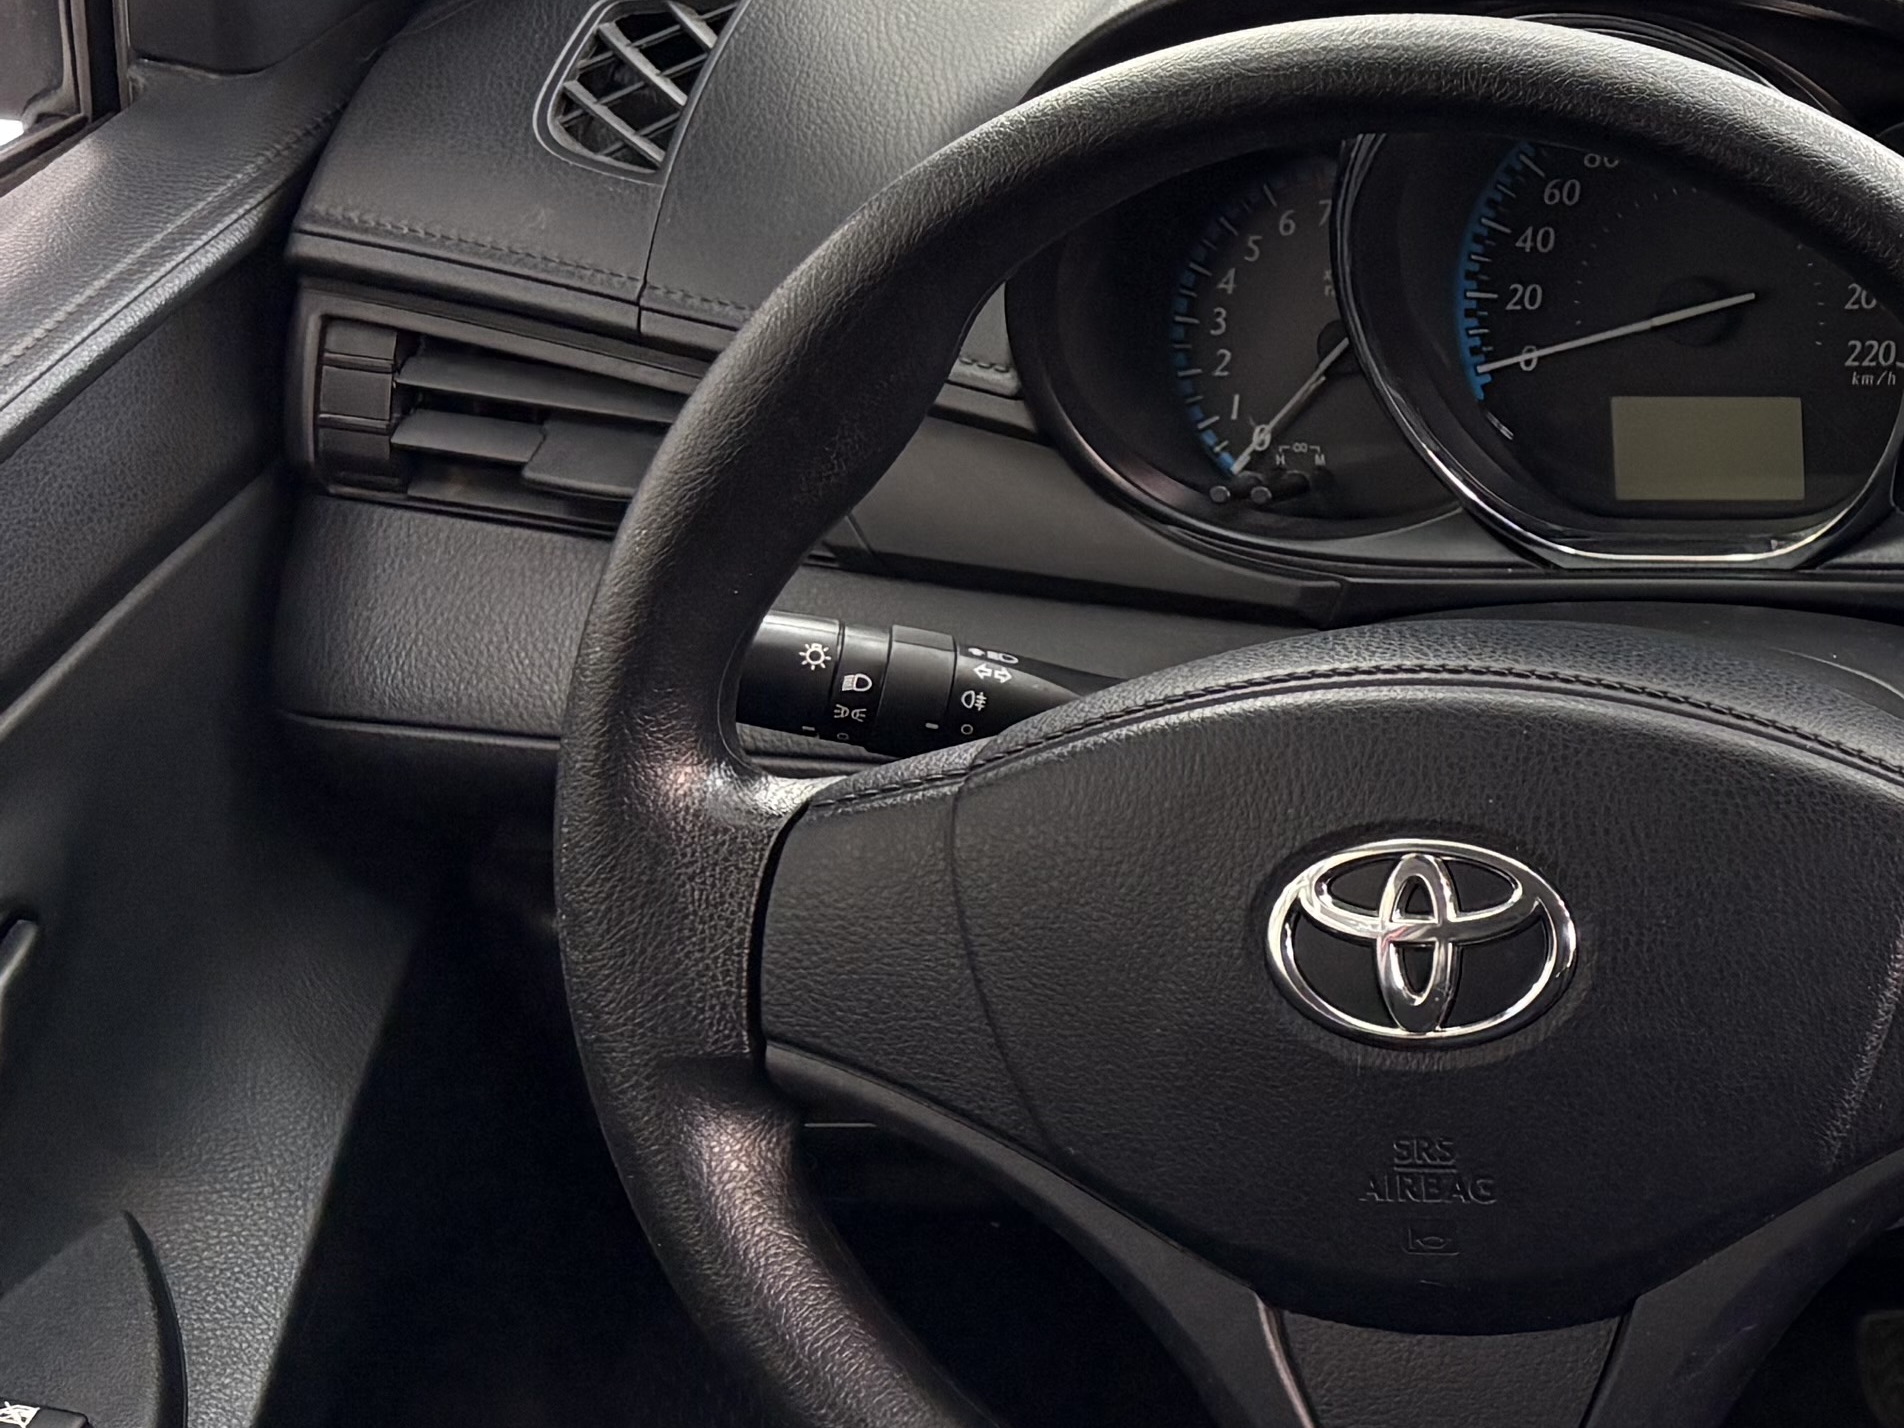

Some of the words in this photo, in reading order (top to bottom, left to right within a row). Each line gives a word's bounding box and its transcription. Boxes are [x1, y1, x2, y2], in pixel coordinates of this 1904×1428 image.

[1543, 179, 1581, 206] 60
[1278, 209, 1296, 236] 6
[1244, 235, 1262, 262] 5
[1515, 226, 1555, 253] 40
[1217, 268, 1238, 295] 4
[1505, 283, 1543, 310] 20
[1210, 307, 1227, 335] 3
[1213, 349, 1232, 376] 2
[1519, 345, 1539, 372] 0
[1844, 340, 1897, 367] 220
[1851, 370, 1897, 385] km/h
[1231, 394, 1240, 420] 1
[1393, 1139, 1455, 1165] SRS
[1358, 1174, 1498, 1204] AIRBAG
